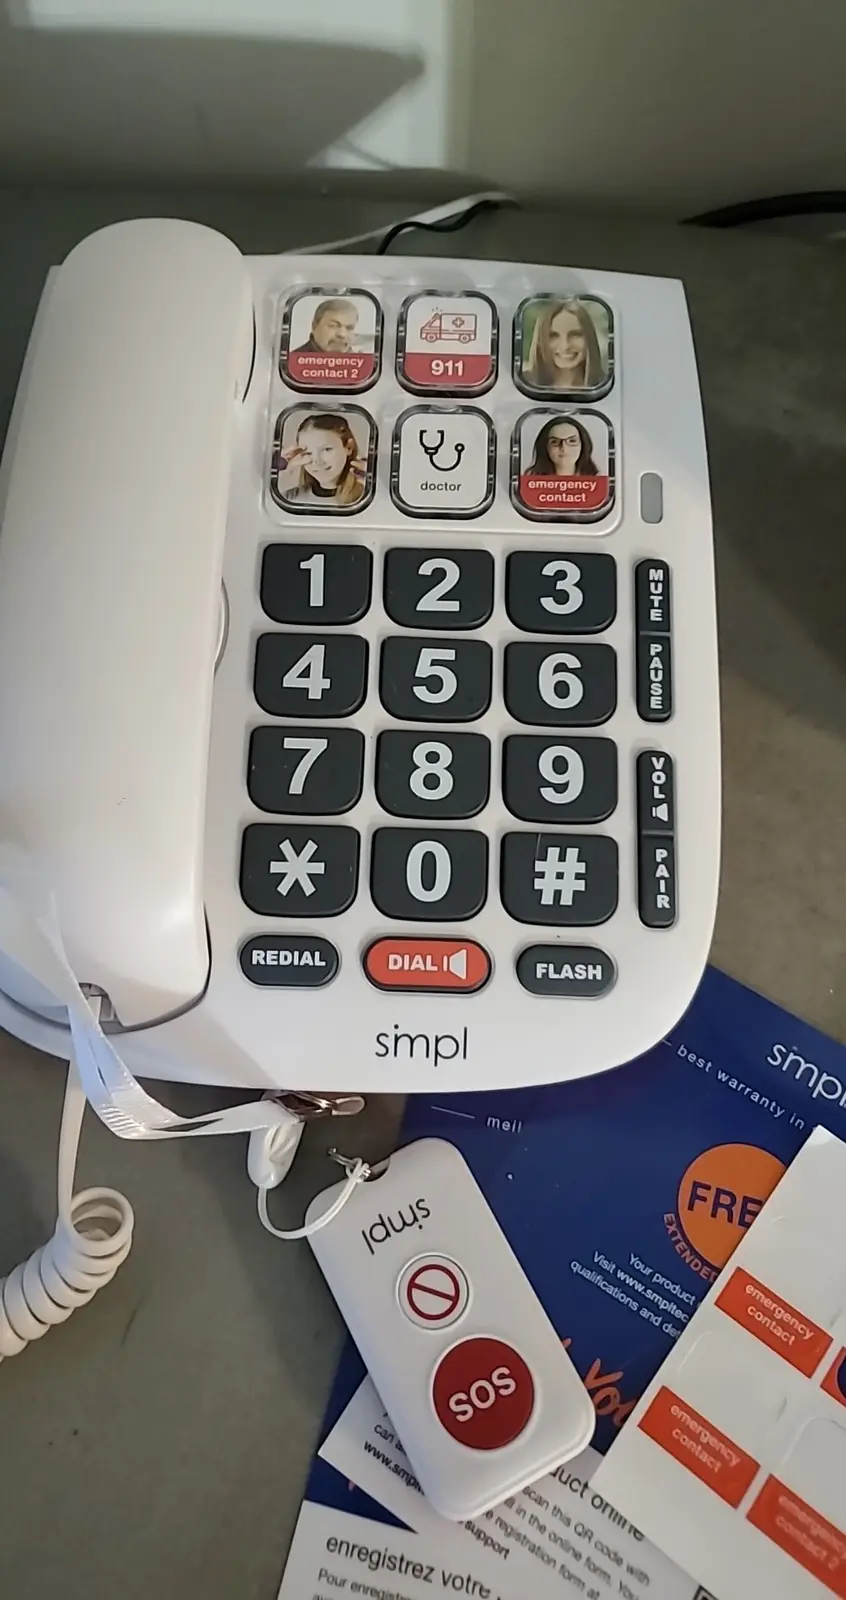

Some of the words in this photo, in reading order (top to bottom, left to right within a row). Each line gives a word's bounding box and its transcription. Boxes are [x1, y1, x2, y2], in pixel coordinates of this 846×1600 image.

[297, 356, 365, 368] emergency
[302, 368, 348, 378] contact
[351, 368, 359, 378] 2
[431, 360, 464, 377] 911
[420, 480, 462, 492] doctor
[528, 480, 597, 492] emergency
[538, 492, 587, 502] contact
[300, 554, 325, 607] 1
[415, 557, 461, 612] 2
[540, 560, 584, 615] 3
[649, 568, 664, 622] MUTE
[282, 644, 331, 700] 4
[412, 647, 458, 704] 5
[538, 652, 584, 709] 6
[649, 643, 663, 709] PAUSE
[283, 737, 328, 795] 7
[409, 741, 454, 800] 8
[538, 745, 585, 805] 9
[651, 756, 666, 799] VOL
[406, 840, 452, 902] 0
[533, 846, 586, 906] #
[655, 848, 671, 909] PAIR
[251, 949, 326, 967] REDIAL
[388, 953, 438, 972] DIAL
[535, 962, 603, 981] FLASH
[677, 1044, 713, 1073] best
[717, 1069, 786, 1118] warranty
[789, 1112, 806, 1130] in
[592, 1250, 617, 1274] Visit
[628, 1252, 653, 1276] Your
[652, 1271, 697, 1307] product
[570, 1260, 639, 1312] qualifications
[639, 1306, 662, 1327] and
[745, 1284, 815, 1340] emergency
[747, 1306, 796, 1346] contact
[449, 1366, 517, 1422] SOS
[670, 1405, 742, 1467] emergency
[672, 1428, 722, 1473] contact
[494, 1516, 557, 1569] registration
[522, 1486, 550, 1511] scan
[551, 1504, 572, 1528] this
[573, 1522, 595, 1544] QR
[594, 1540, 624, 1567] code
[528, 1513, 548, 1535] the
[317, 1567, 348, 1588] Pour
[325, 1535, 436, 1584] enregistrez
